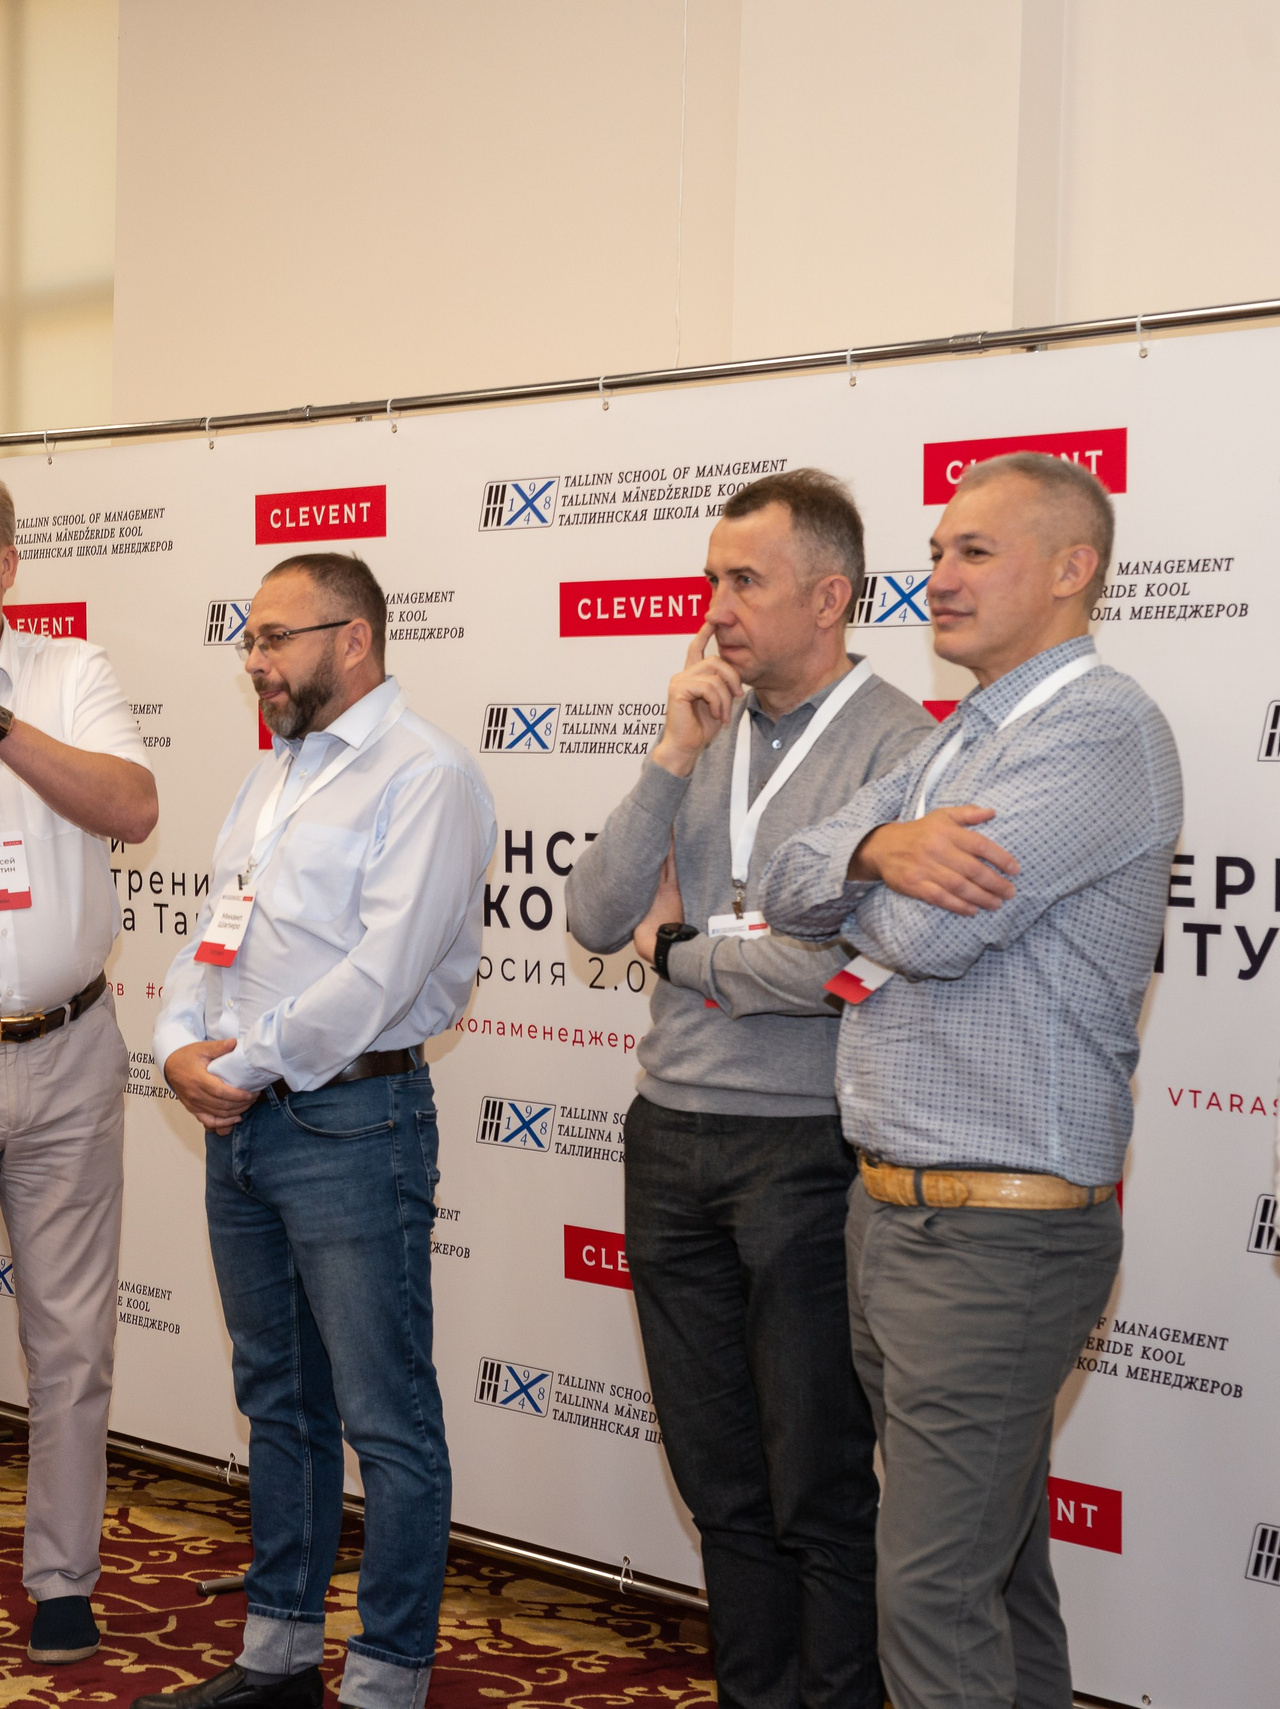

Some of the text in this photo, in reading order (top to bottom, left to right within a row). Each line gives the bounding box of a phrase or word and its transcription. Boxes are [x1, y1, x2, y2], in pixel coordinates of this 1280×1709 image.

[564, 459, 787, 488] TALLINN SCHOOL OF MANAGEMENT
[561, 482, 751, 507] TALLINNA MÄNEDŽERIDE KOO
[16, 507, 165, 530] TALLINN SCHOOL OF MANAGEMENT
[270, 502, 371, 529] CLEVENT
[558, 509, 648, 526] ТАЛЛИННСКАЯ
[652, 506, 699, 521] ШКОЛА
[14, 532, 52, 545] TALLINNA
[119, 526, 144, 538] KOOL
[17, 541, 173, 560] АЛЛИННСКАЯ ШКОЛА МЕНЕДЖЕРОВ
[1117, 557, 1234, 576] MANAGEMENT
[1099, 582, 1191, 599] RIDE KOOL
[398, 610, 428, 622] KOOL
[577, 594, 703, 620] CLEVENT
[1090, 603, 1249, 622] ОЛА МЕНЕДЖЕРОВ
[7, 616, 75, 635] EVENT
[389, 627, 465, 642] МЕНЕДЖЕРОВ
[565, 703, 667, 716] TALLINN SCHOOL
[562, 723, 617, 735] TALLINNA
[559, 742, 649, 755] ТАЛЛИННСКАЯ
[110, 868, 210, 900] трени
[1168, 854, 1280, 912] ЕР
[153, 903, 199, 935] Та
[483, 884, 571, 933] КО
[1154, 922, 1280, 981] ТУ
[476, 956, 646, 993] рсия 2.0
[455, 1017, 645, 1054] коламенеджер
[560, 1106, 608, 1123] TALLINN
[557, 1124, 612, 1144] TALLINNA
[554, 1142, 625, 1163] ТАЛЛИННСК
[430, 1241, 471, 1259] ЖЕРОВ
[582, 1245, 630, 1272] CLE
[118, 1280, 172, 1301] ANAGEMENT
[126, 1297, 151, 1312] KOOL
[119, 1312, 181, 1335] МЕНЕДЖЕРОВ
[1113, 1319, 1229, 1352] MANAGEMENT
[1086, 1336, 1186, 1367] ERIDE KOOL
[557, 1373, 654, 1405] TALLINN SCHOO
[1076, 1356, 1244, 1399] КОЛА МЕНЕДЖЕРОВ
[555, 1391, 609, 1414] TALLINNA
[552, 1408, 640, 1439] ТАЛЛИННСКАЯ
[1056, 1497, 1098, 1529] NT
